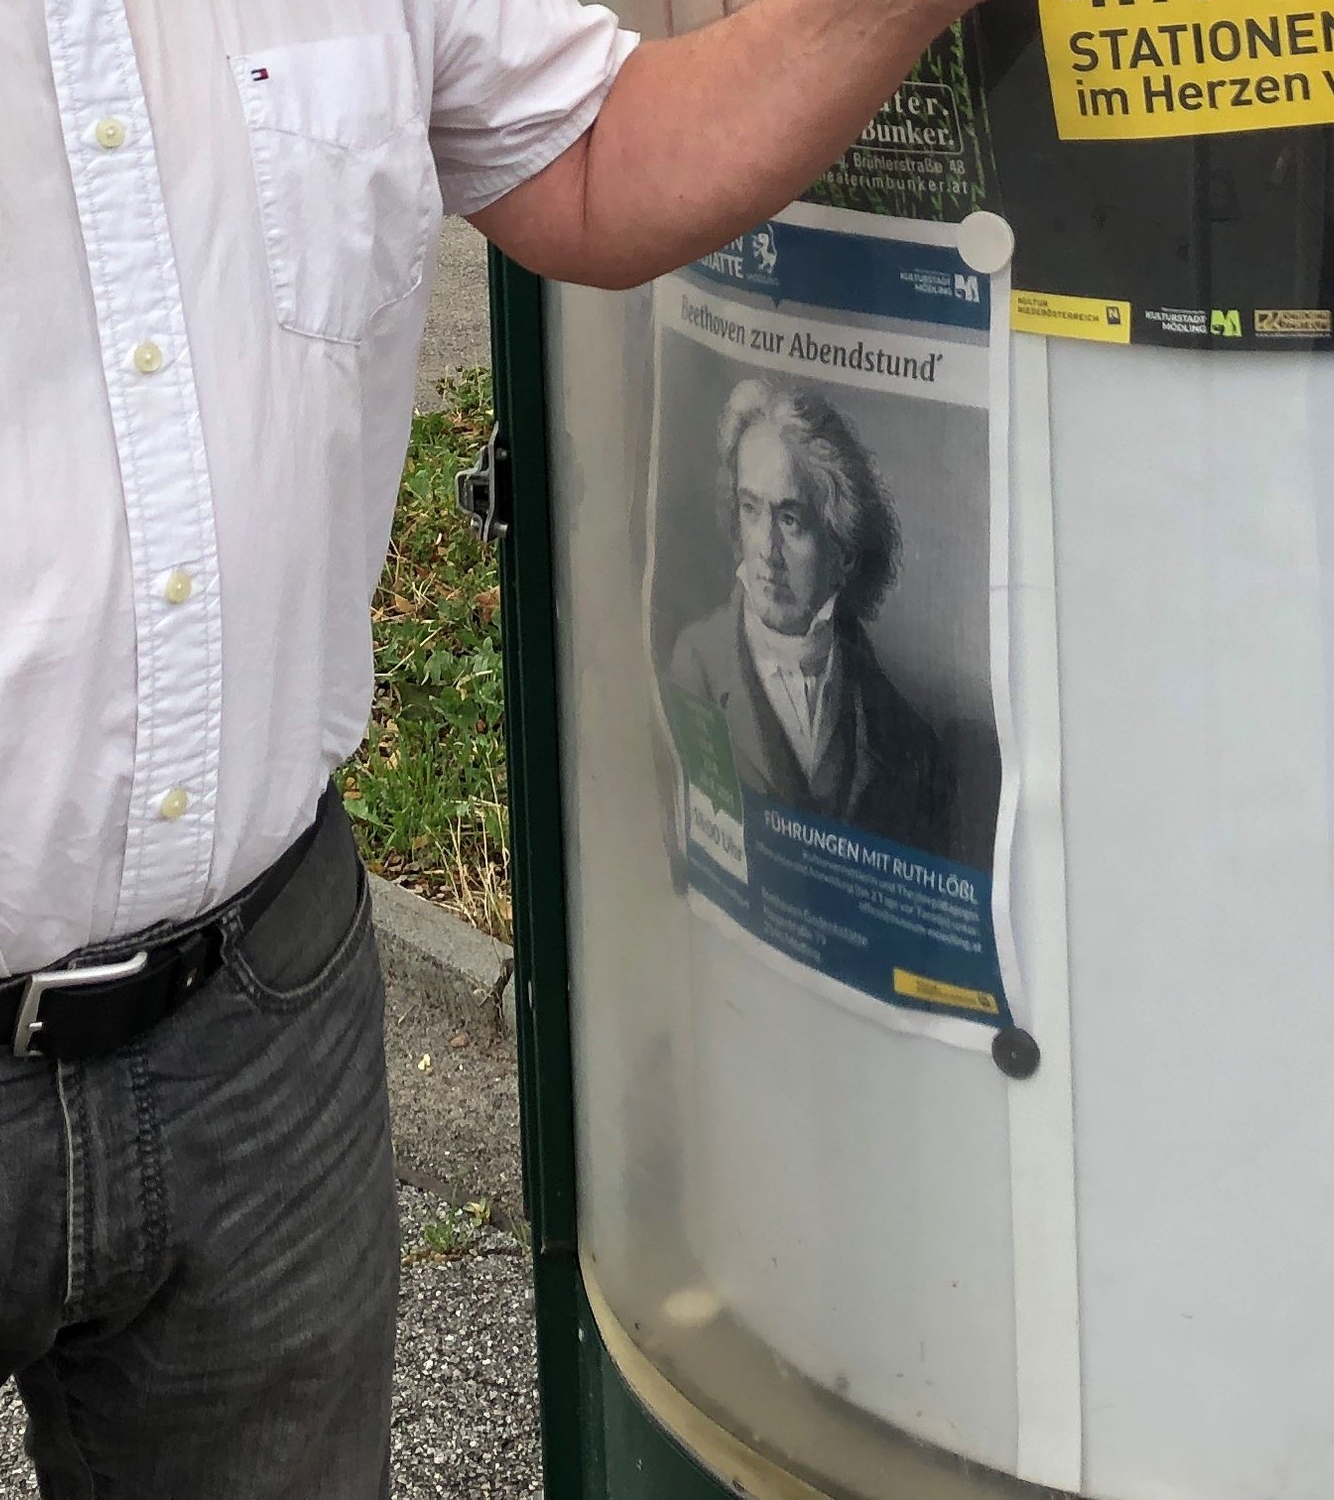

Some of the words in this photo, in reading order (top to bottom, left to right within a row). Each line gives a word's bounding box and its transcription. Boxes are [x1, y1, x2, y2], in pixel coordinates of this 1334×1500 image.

[1074, 79, 1130, 117] im
[1142, 71, 1311, 114] Herzen
[949, 159, 966, 176] 48
[822, 169, 968, 195] eaterimbunker.at
[680, 294, 746, 348] Beethoven
[750, 327, 784, 356] zur
[1145, 309, 1208, 324] KULTURSTADT
[1161, 321, 1208, 334] MÖDLING
[763, 808, 861, 863] FÜHRUNGEN
[861, 846, 891, 873] MIT
[891, 858, 937, 891] RUTH
